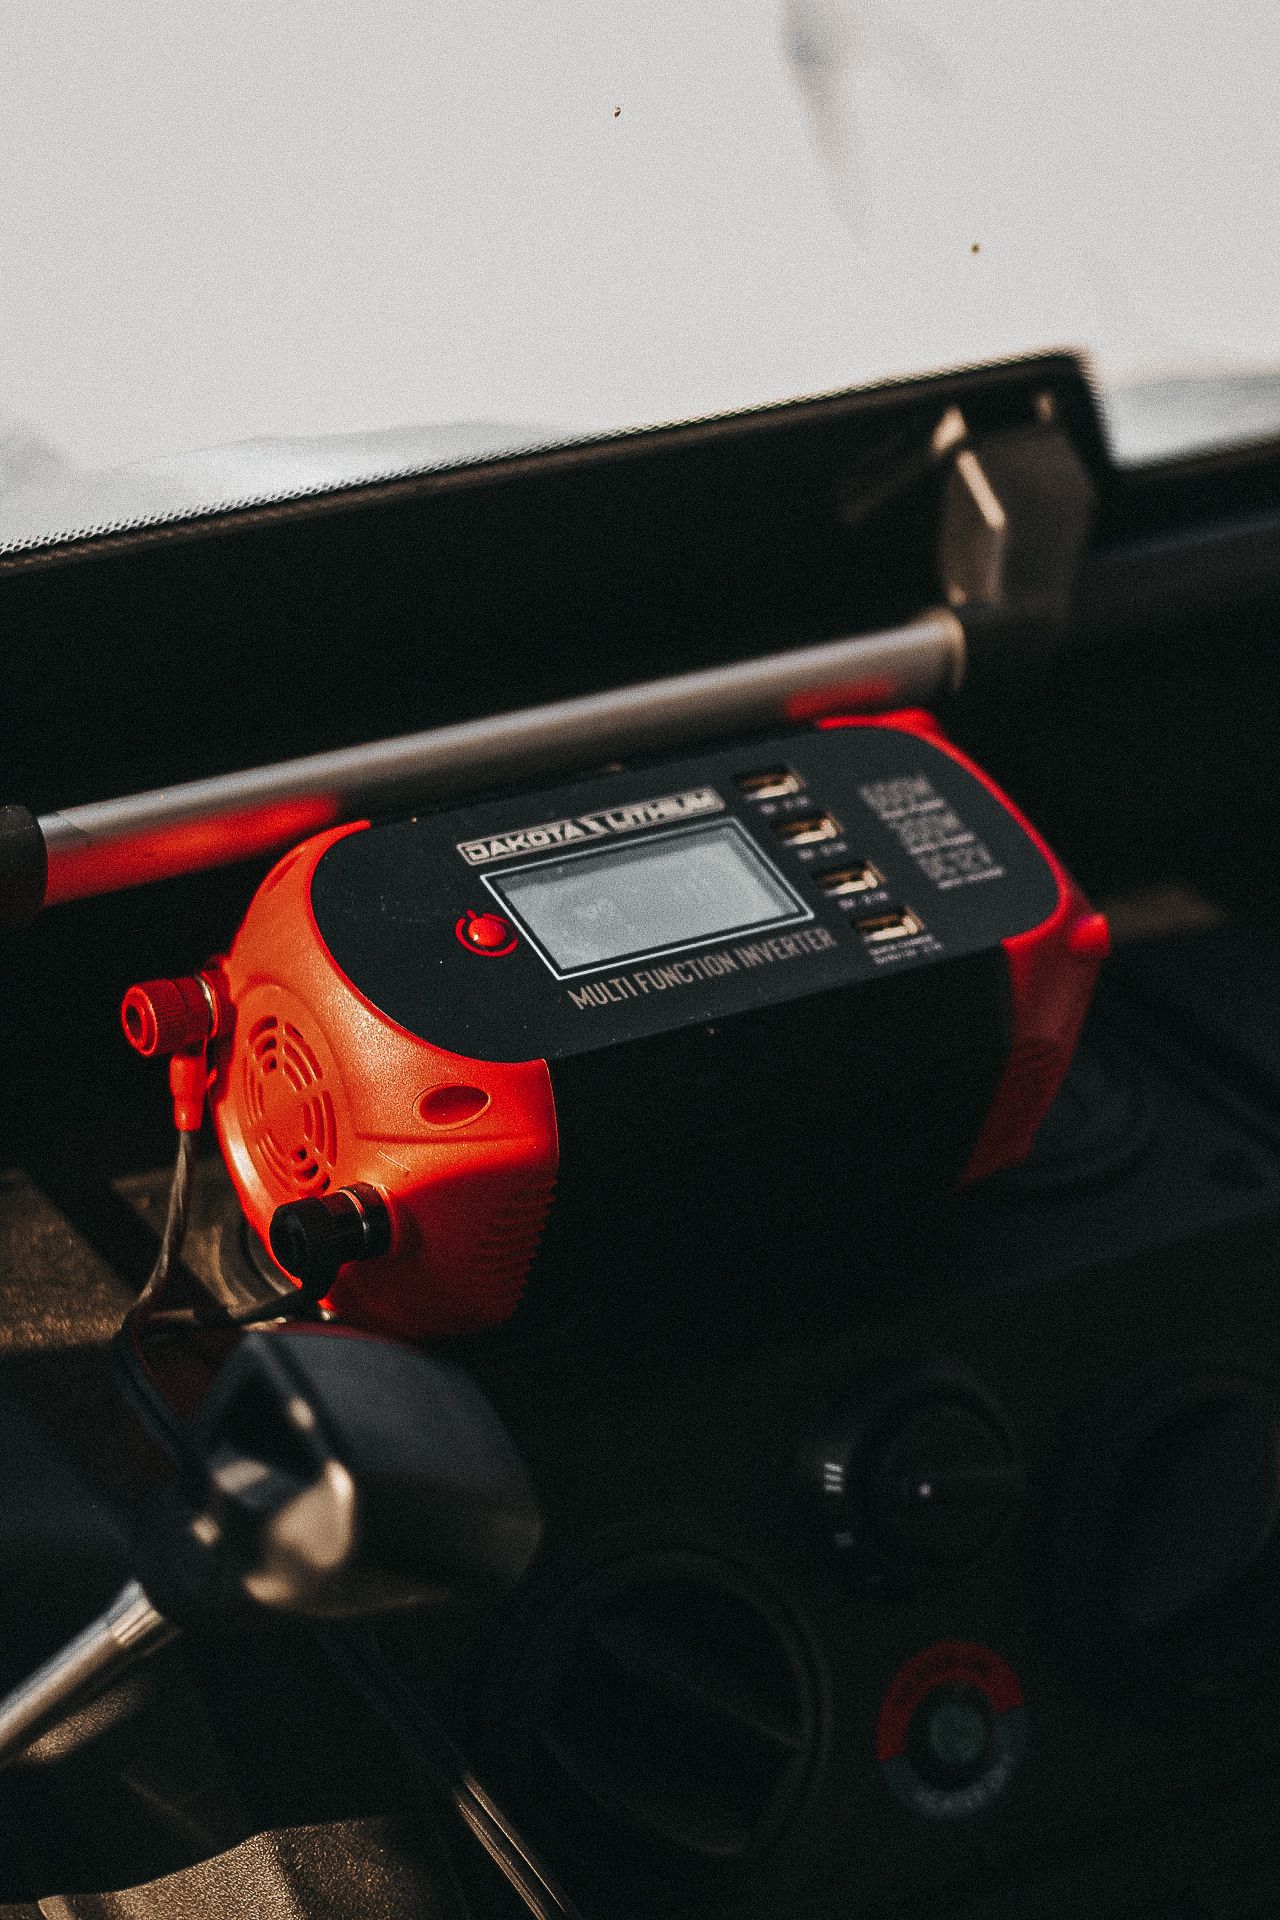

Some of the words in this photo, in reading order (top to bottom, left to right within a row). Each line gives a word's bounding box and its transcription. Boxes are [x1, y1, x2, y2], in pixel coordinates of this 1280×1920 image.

[464, 823, 586, 860] DAKOTA
[567, 977, 638, 1010] MULTI
[633, 950, 739, 992] FUNCTION
[734, 928, 837, 969] INVERTER
